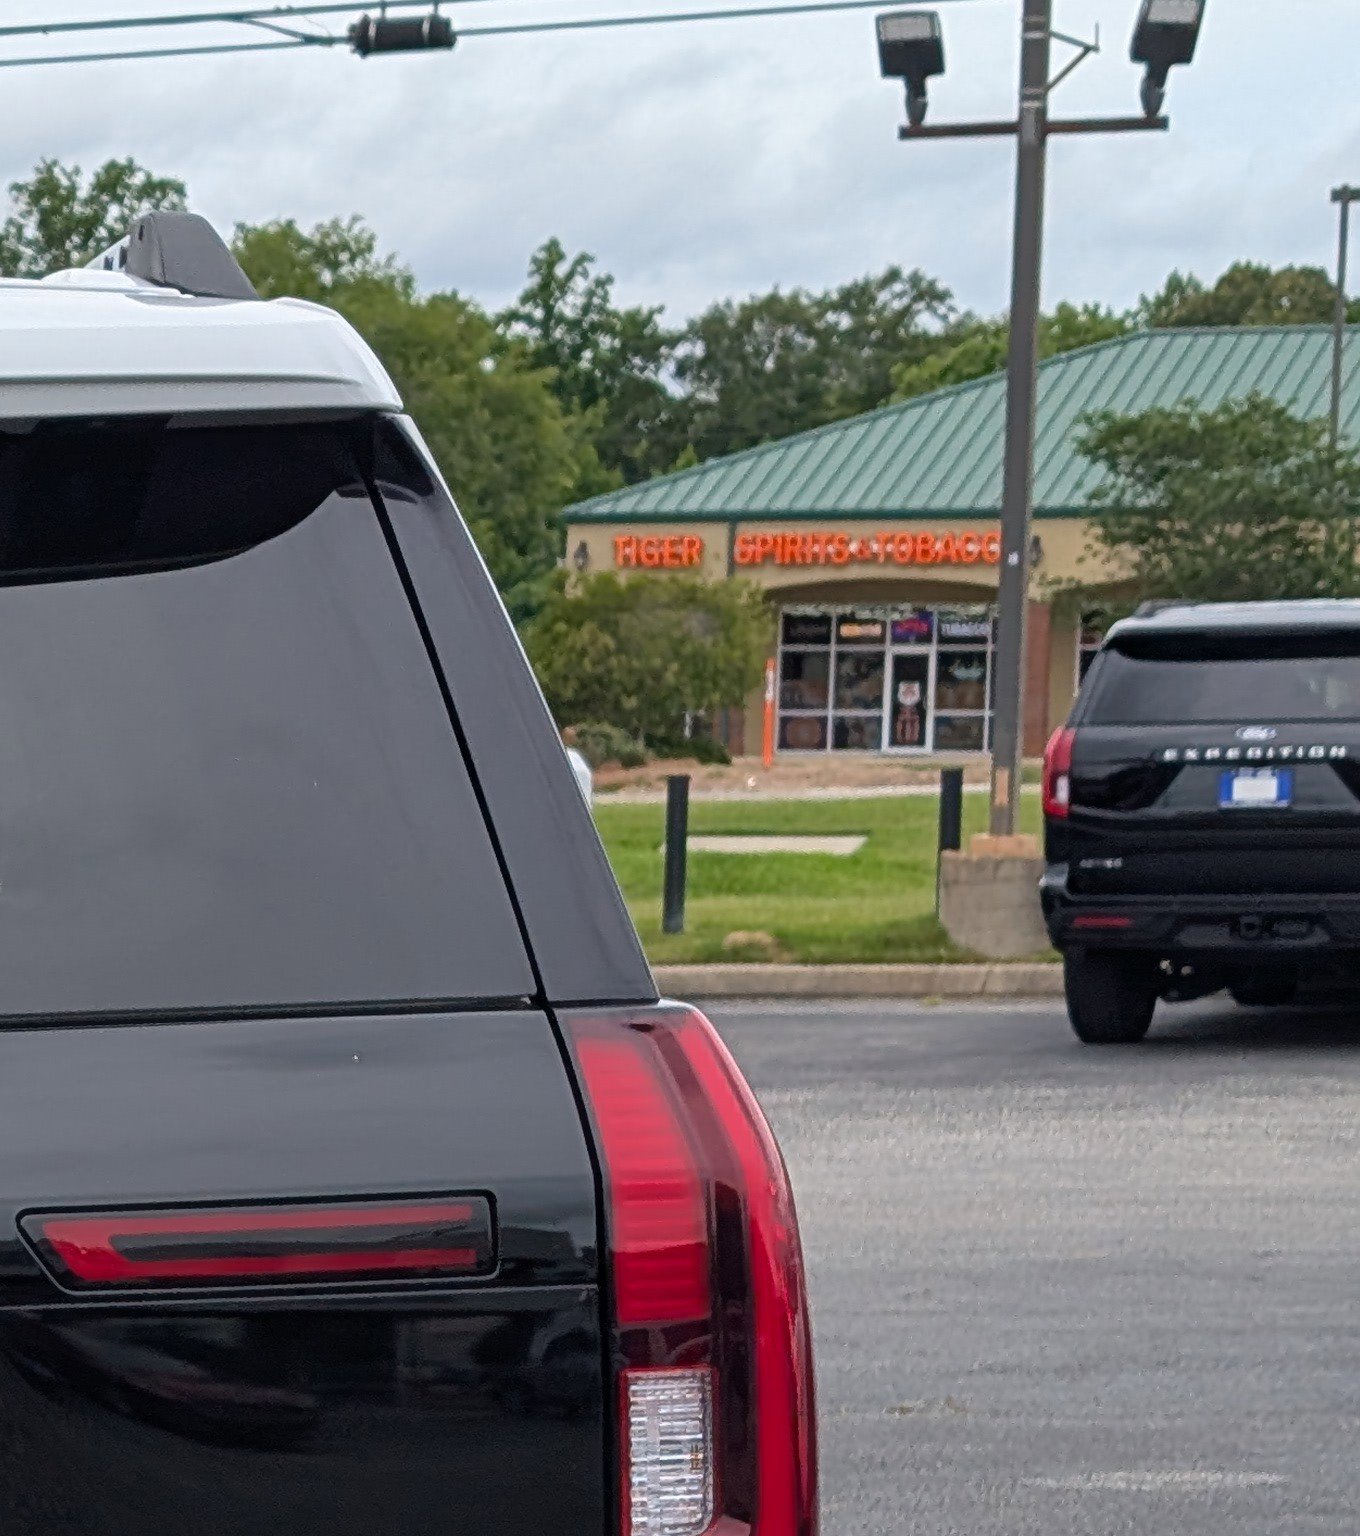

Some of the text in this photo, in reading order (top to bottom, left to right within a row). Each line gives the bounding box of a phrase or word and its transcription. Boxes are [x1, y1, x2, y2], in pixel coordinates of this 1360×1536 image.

[614, 535, 704, 568] TIGER
[734, 532, 850, 566] SPIRITS
[875, 531, 1001, 565] TOBACC
